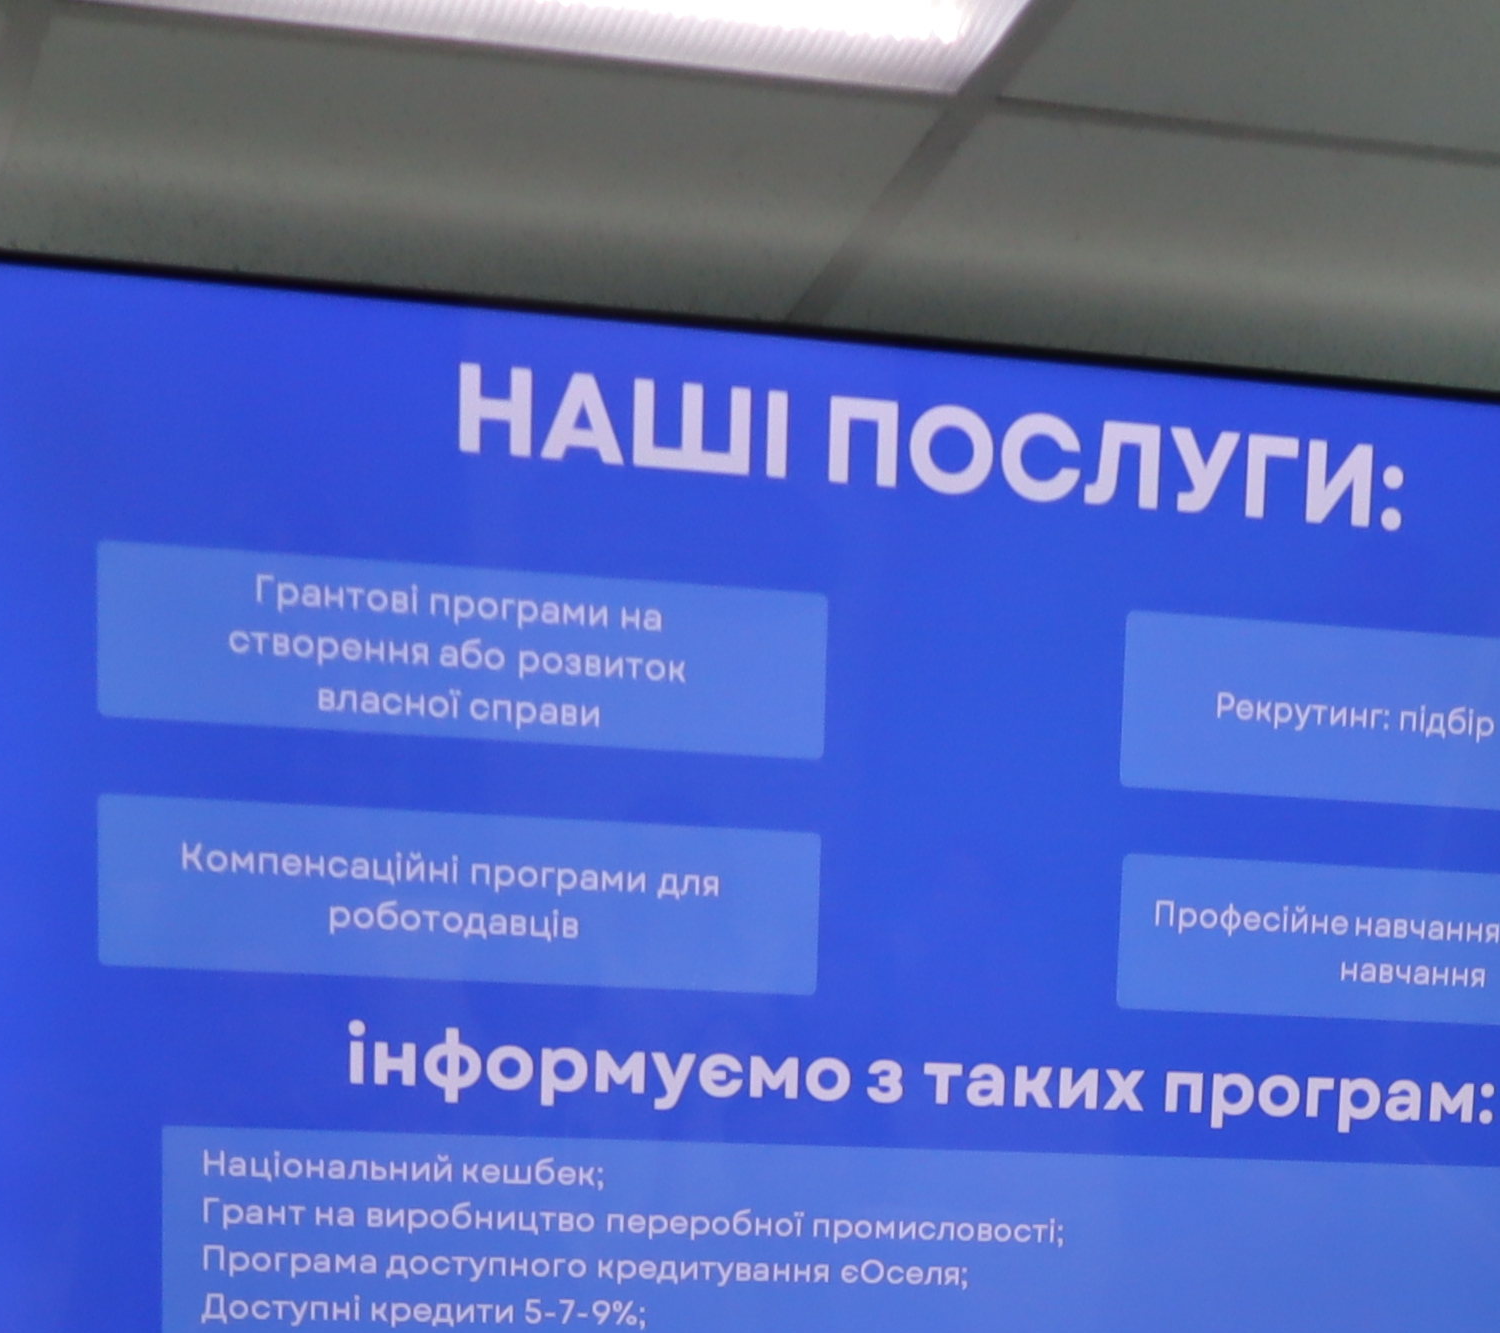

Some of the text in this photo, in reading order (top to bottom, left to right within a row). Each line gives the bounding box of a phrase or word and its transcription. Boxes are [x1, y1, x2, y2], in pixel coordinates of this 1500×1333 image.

[459, 363, 1403, 531] НАШІ ПОСЛУГИ:
[256, 574, 662, 632] Грантові програми на
[229, 630, 685, 683] створення або розвиток
[318, 688, 600, 729] власної справи
[1217, 692, 1389, 731] Рекрутинг:
[1400, 705, 1494, 743] підбір
[182, 842, 719, 899] Компенсаційні програми для
[330, 900, 578, 942] роботодавців
[1155, 900, 1349, 936] Професійне
[1341, 962, 1485, 987] навчання
[349, 1020, 1494, 1133] інформуємо з таких програм:
[203, 1150, 603, 1190] Національний кешбек;
[203, 1197, 1063, 1247] Грант на виробництво переробної промисловості;
[203, 1244, 967, 1290] Програма доступного кредитування єОселя;
[201, 1293, 645, 1330] Доступні кредити 5-7-9%;
